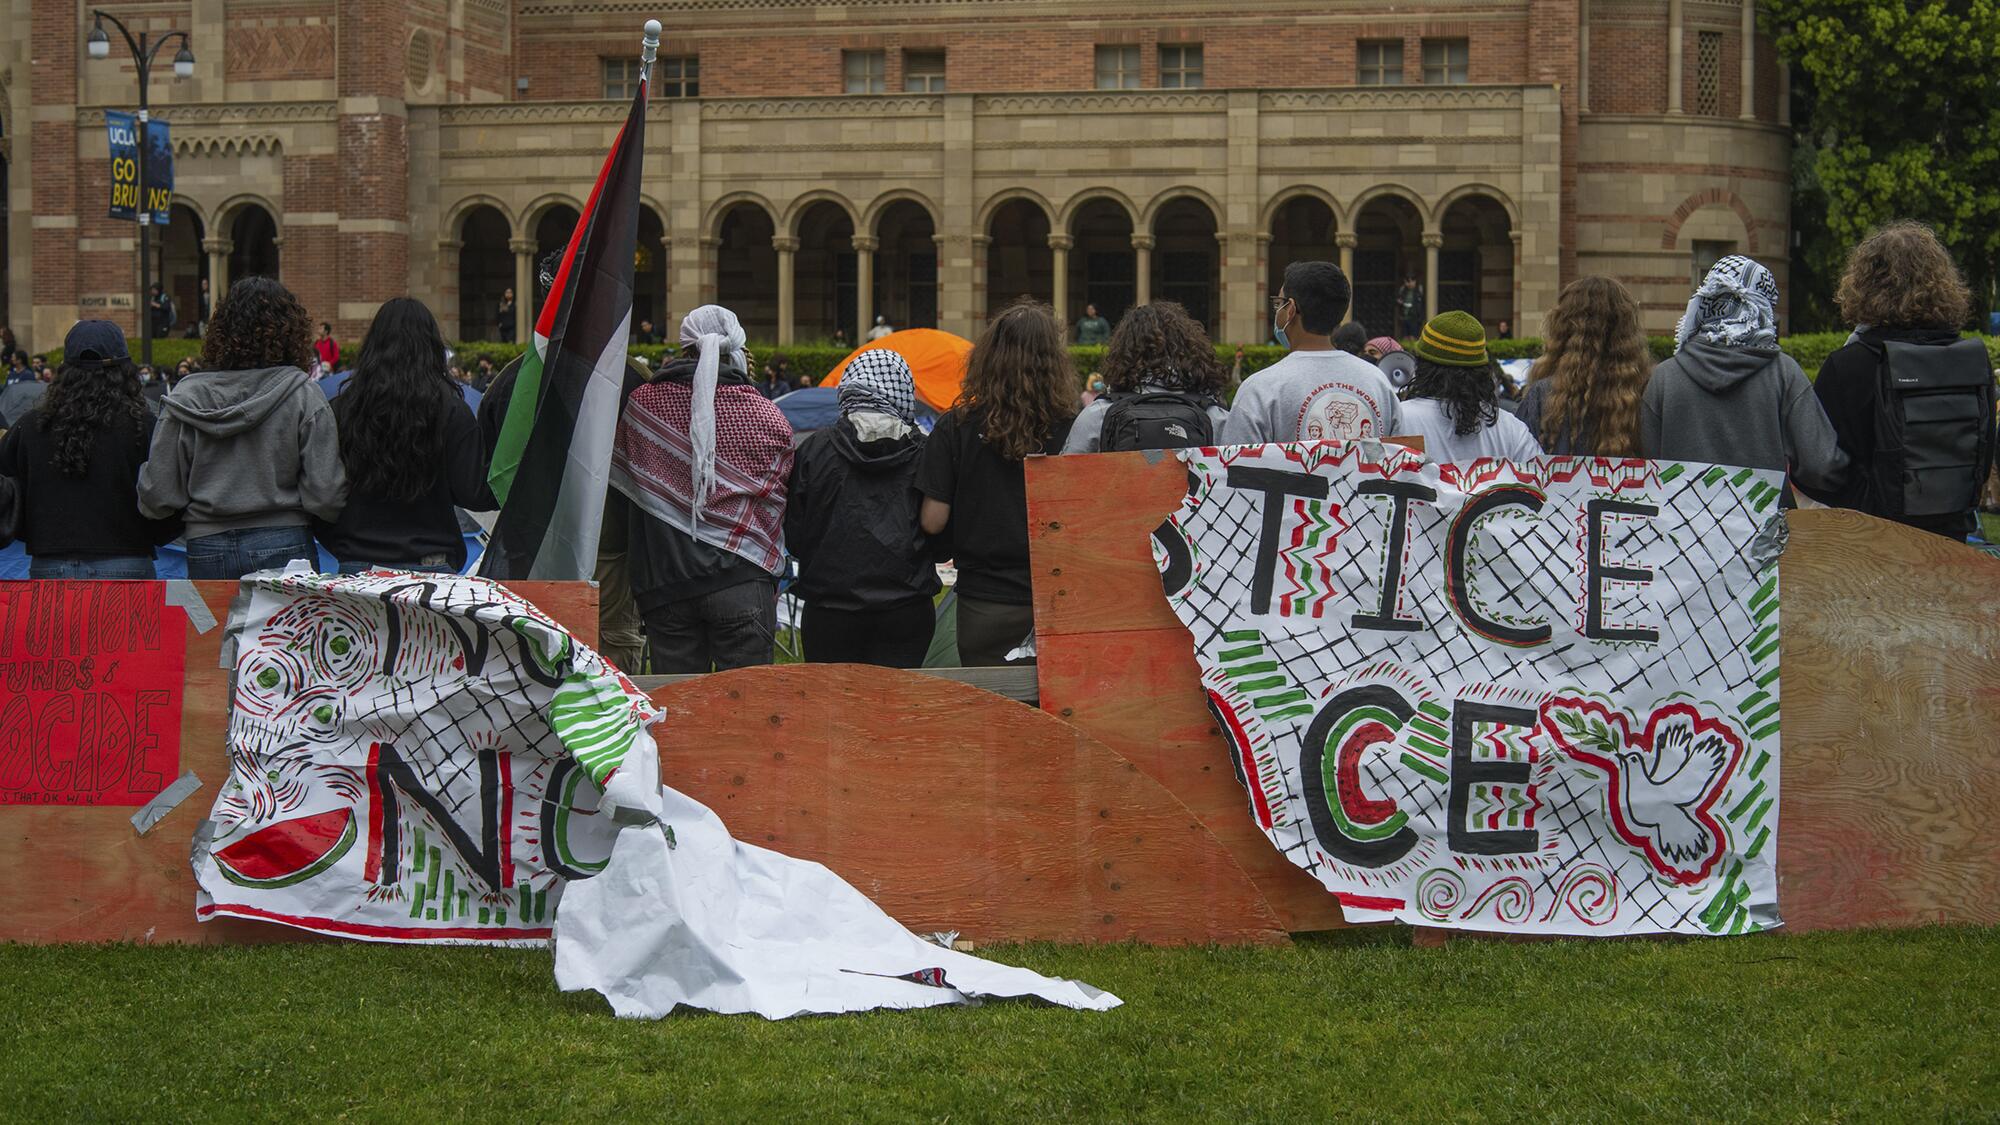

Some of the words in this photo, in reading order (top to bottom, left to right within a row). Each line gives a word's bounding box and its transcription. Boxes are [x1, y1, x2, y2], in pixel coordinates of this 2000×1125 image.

[110, 127, 136, 147] UCLA
[113, 157, 136, 181] GO
[112, 182, 172, 212] BRUNS!
[1311, 382, 1334, 396] MAKE
[1336, 382, 1354, 391] THE
[1356, 388, 1381, 418] WORLD
